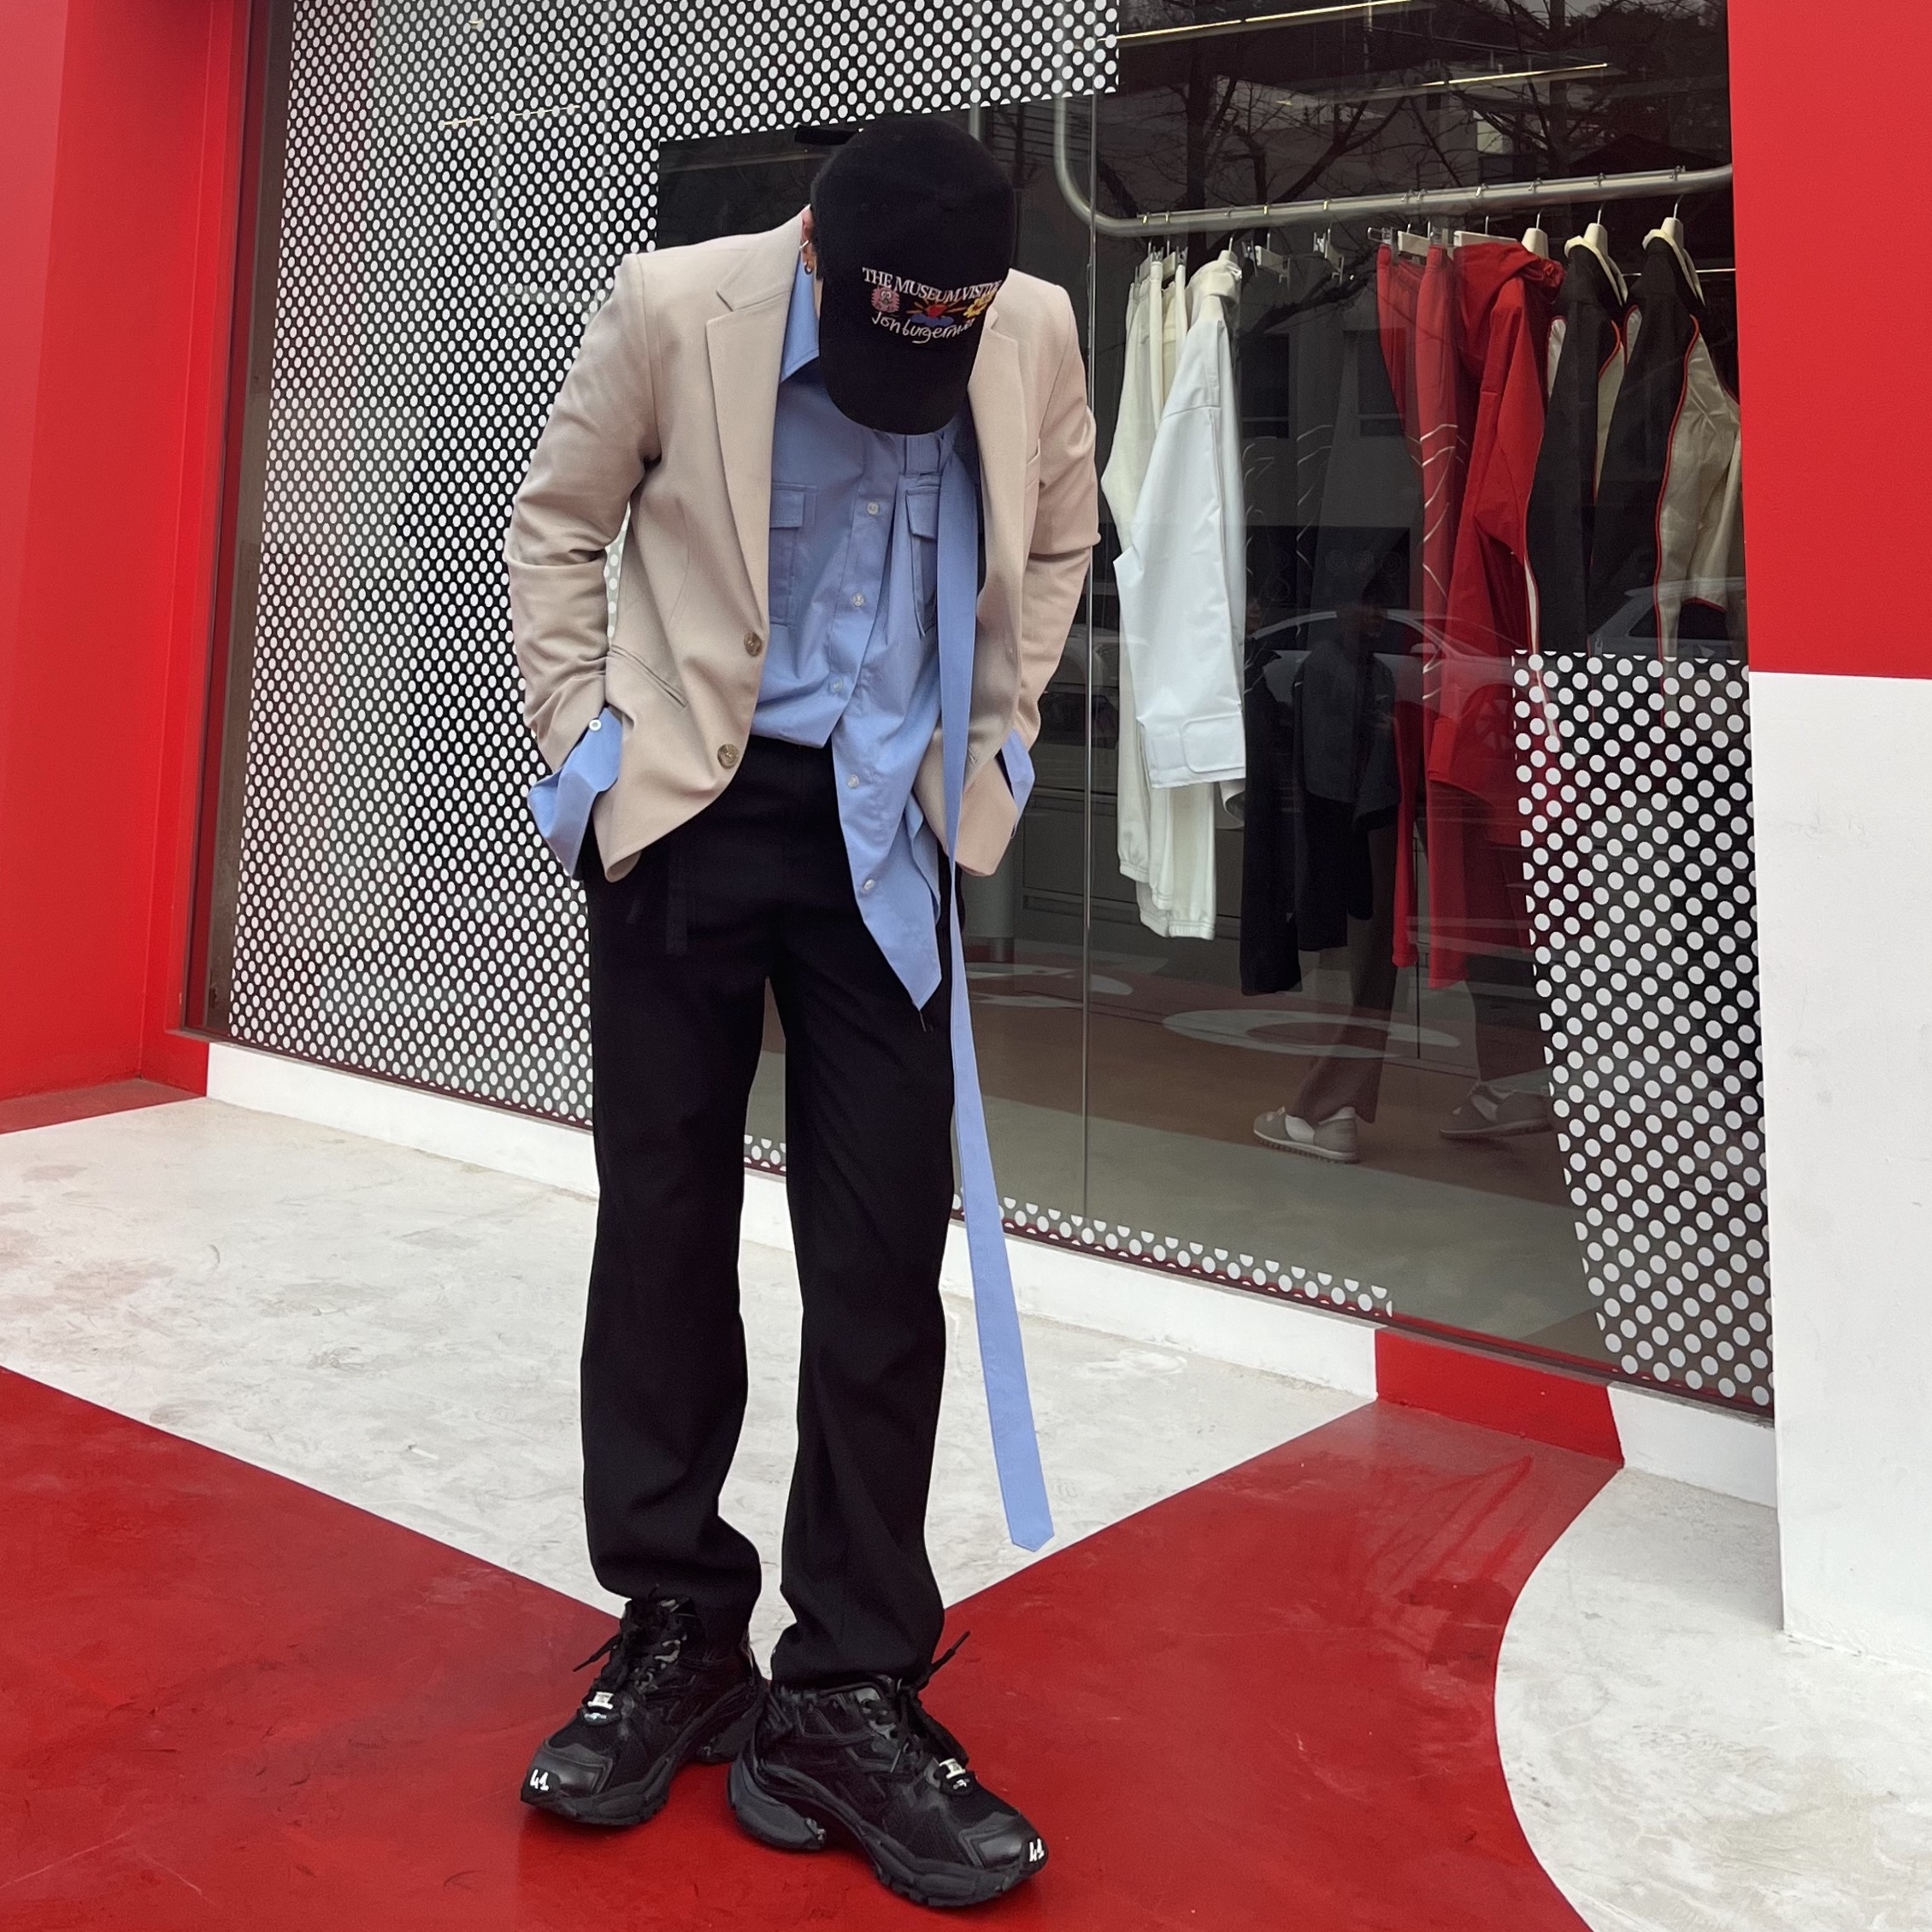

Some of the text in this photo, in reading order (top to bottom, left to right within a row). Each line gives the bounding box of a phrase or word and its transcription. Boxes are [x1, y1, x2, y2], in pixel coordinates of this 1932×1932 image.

[862, 267, 893, 288] THE
[895, 276, 962, 303] MUSEUM
[529, 1769, 550, 1791] 41
[1028, 1838, 1045, 1862] 41
